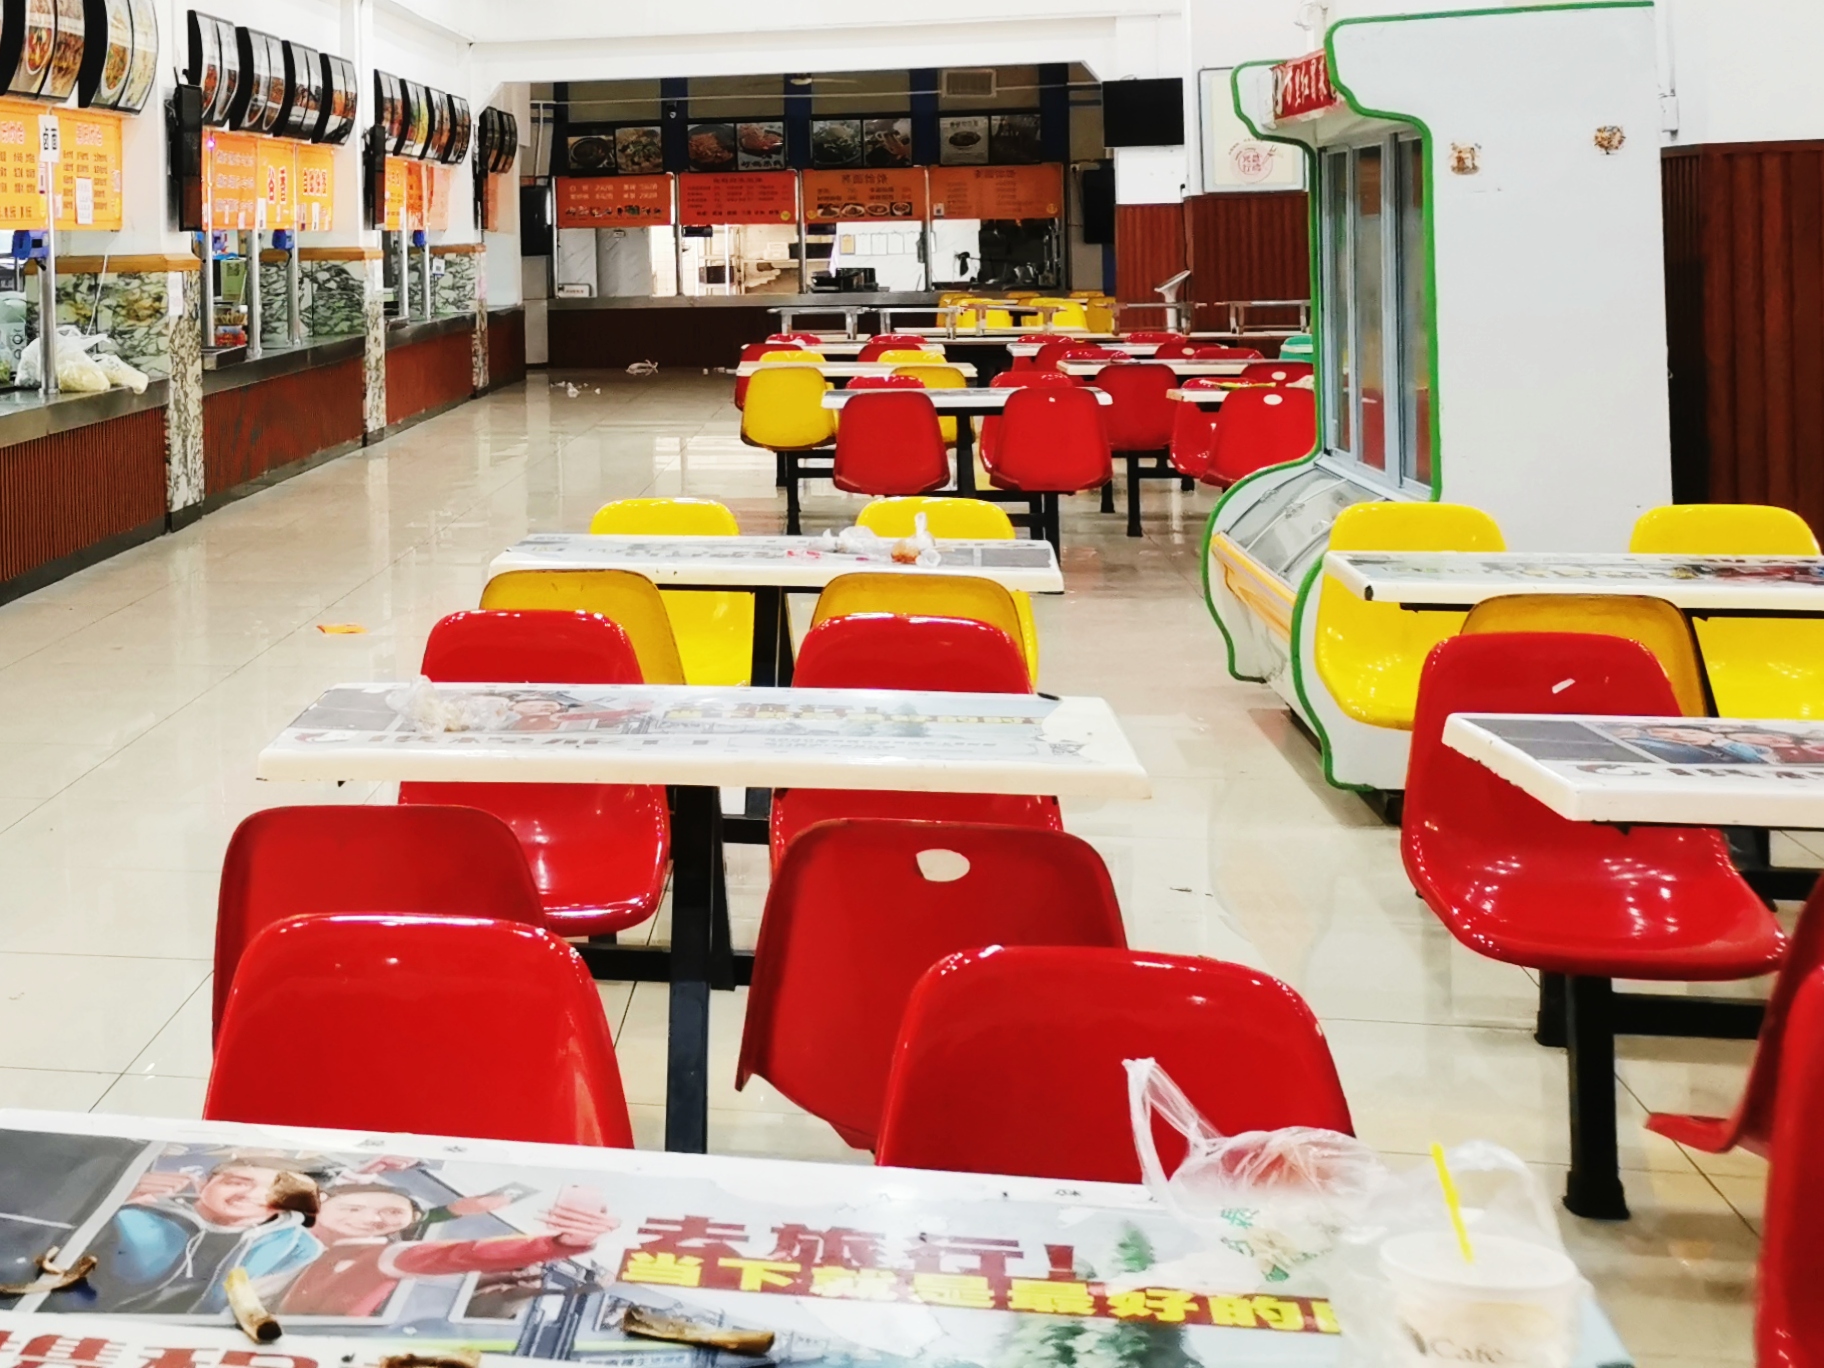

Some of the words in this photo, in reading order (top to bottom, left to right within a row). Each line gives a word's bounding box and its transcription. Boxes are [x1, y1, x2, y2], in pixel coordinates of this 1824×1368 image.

[621, 1250, 1341, 1334] 当下就是最好的
